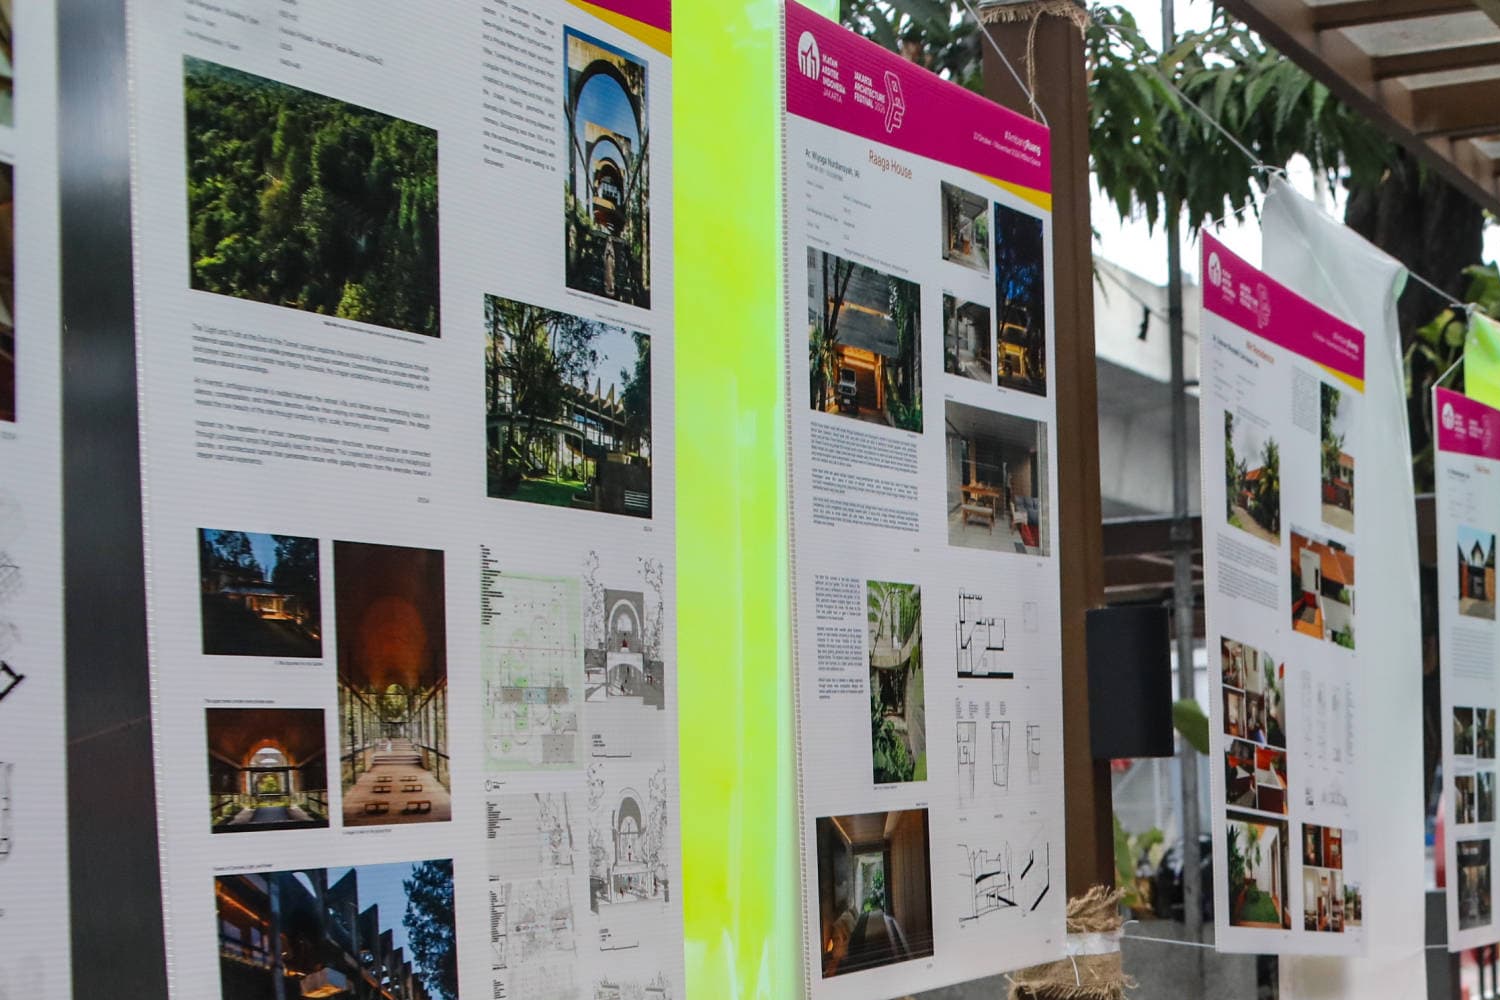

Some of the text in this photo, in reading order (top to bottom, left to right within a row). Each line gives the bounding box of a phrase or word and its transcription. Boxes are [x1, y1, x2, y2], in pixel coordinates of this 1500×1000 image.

[854, 71, 873, 87] JAKARTA
[854, 82, 886, 103] ARCHITECTURE
[854, 92, 874, 108] FESTIVAL
[868, 149, 890, 172] Raaga
[891, 158, 913, 180] House
